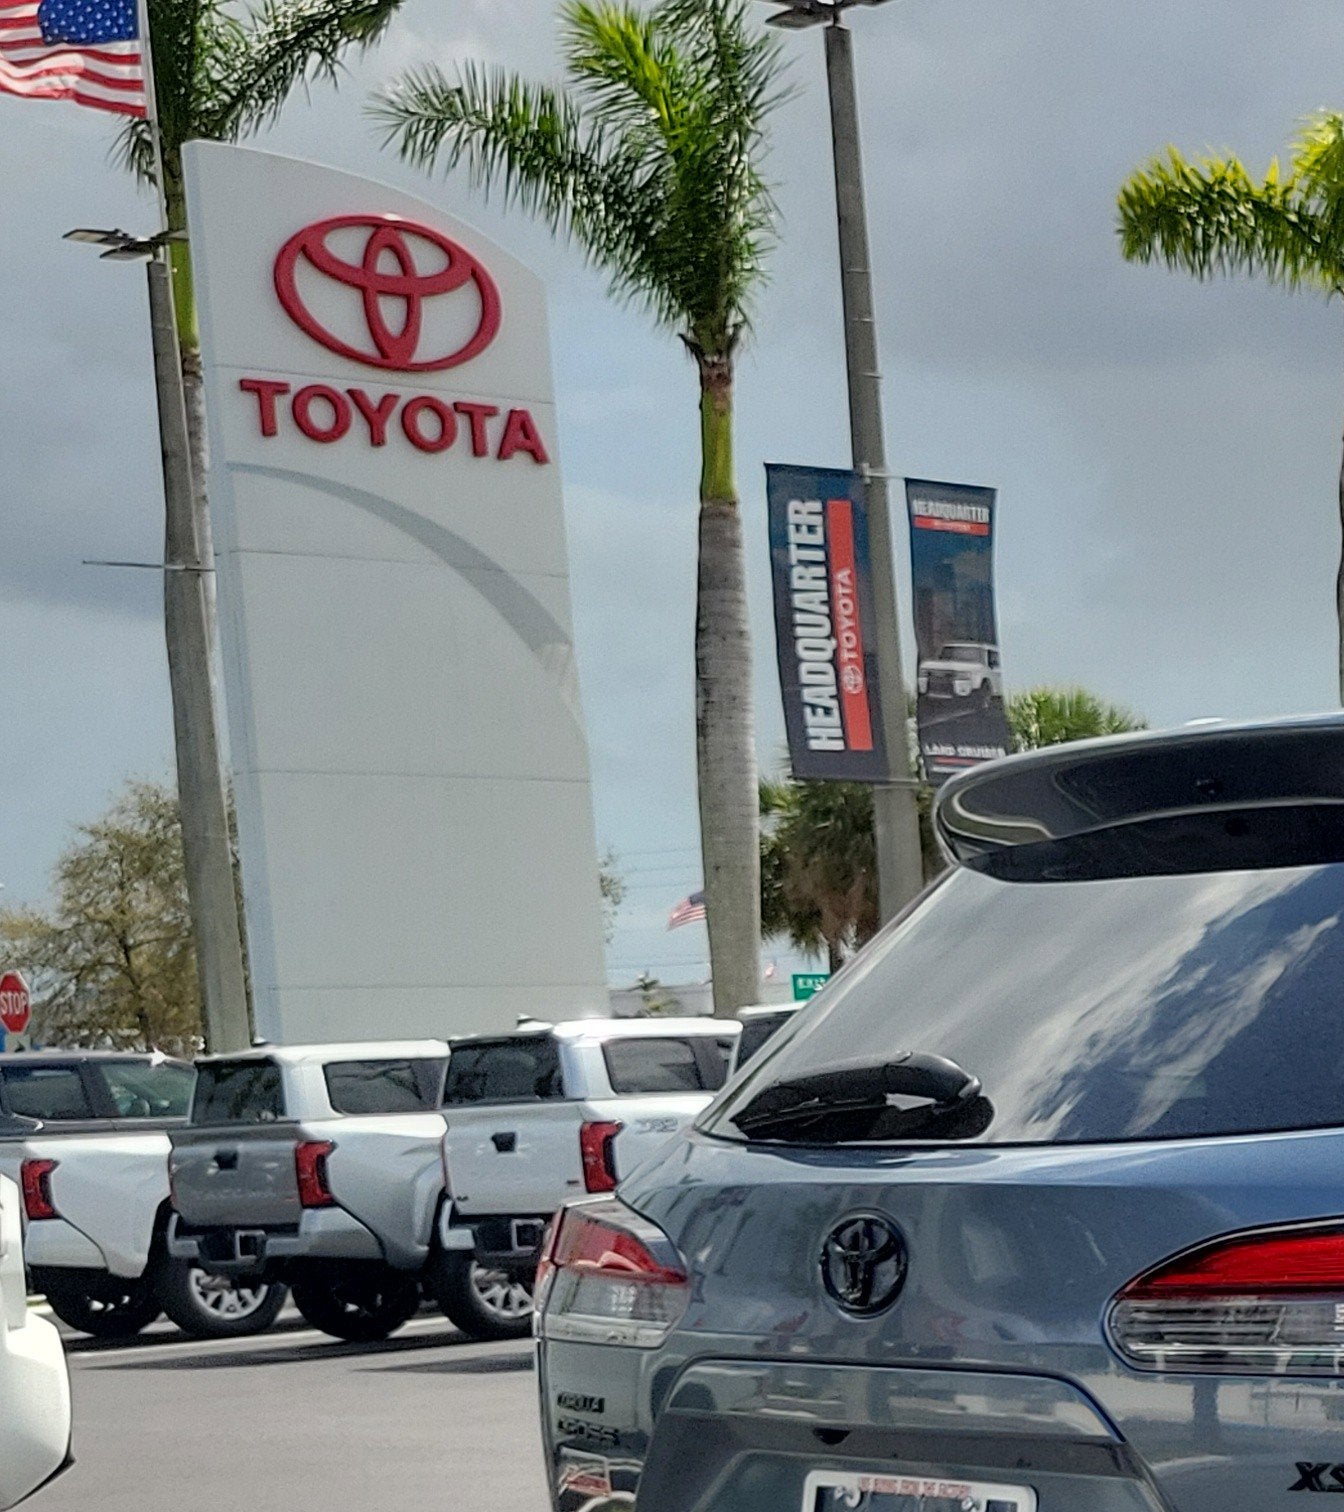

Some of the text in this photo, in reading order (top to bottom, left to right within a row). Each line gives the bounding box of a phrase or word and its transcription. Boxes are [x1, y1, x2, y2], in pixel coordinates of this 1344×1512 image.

[240, 379, 549, 465] TOYOTA
[789, 499, 846, 751] HEADQUARTER
[836, 567, 859, 662] TOYOTA
[0, 991, 27, 1015] STOP
